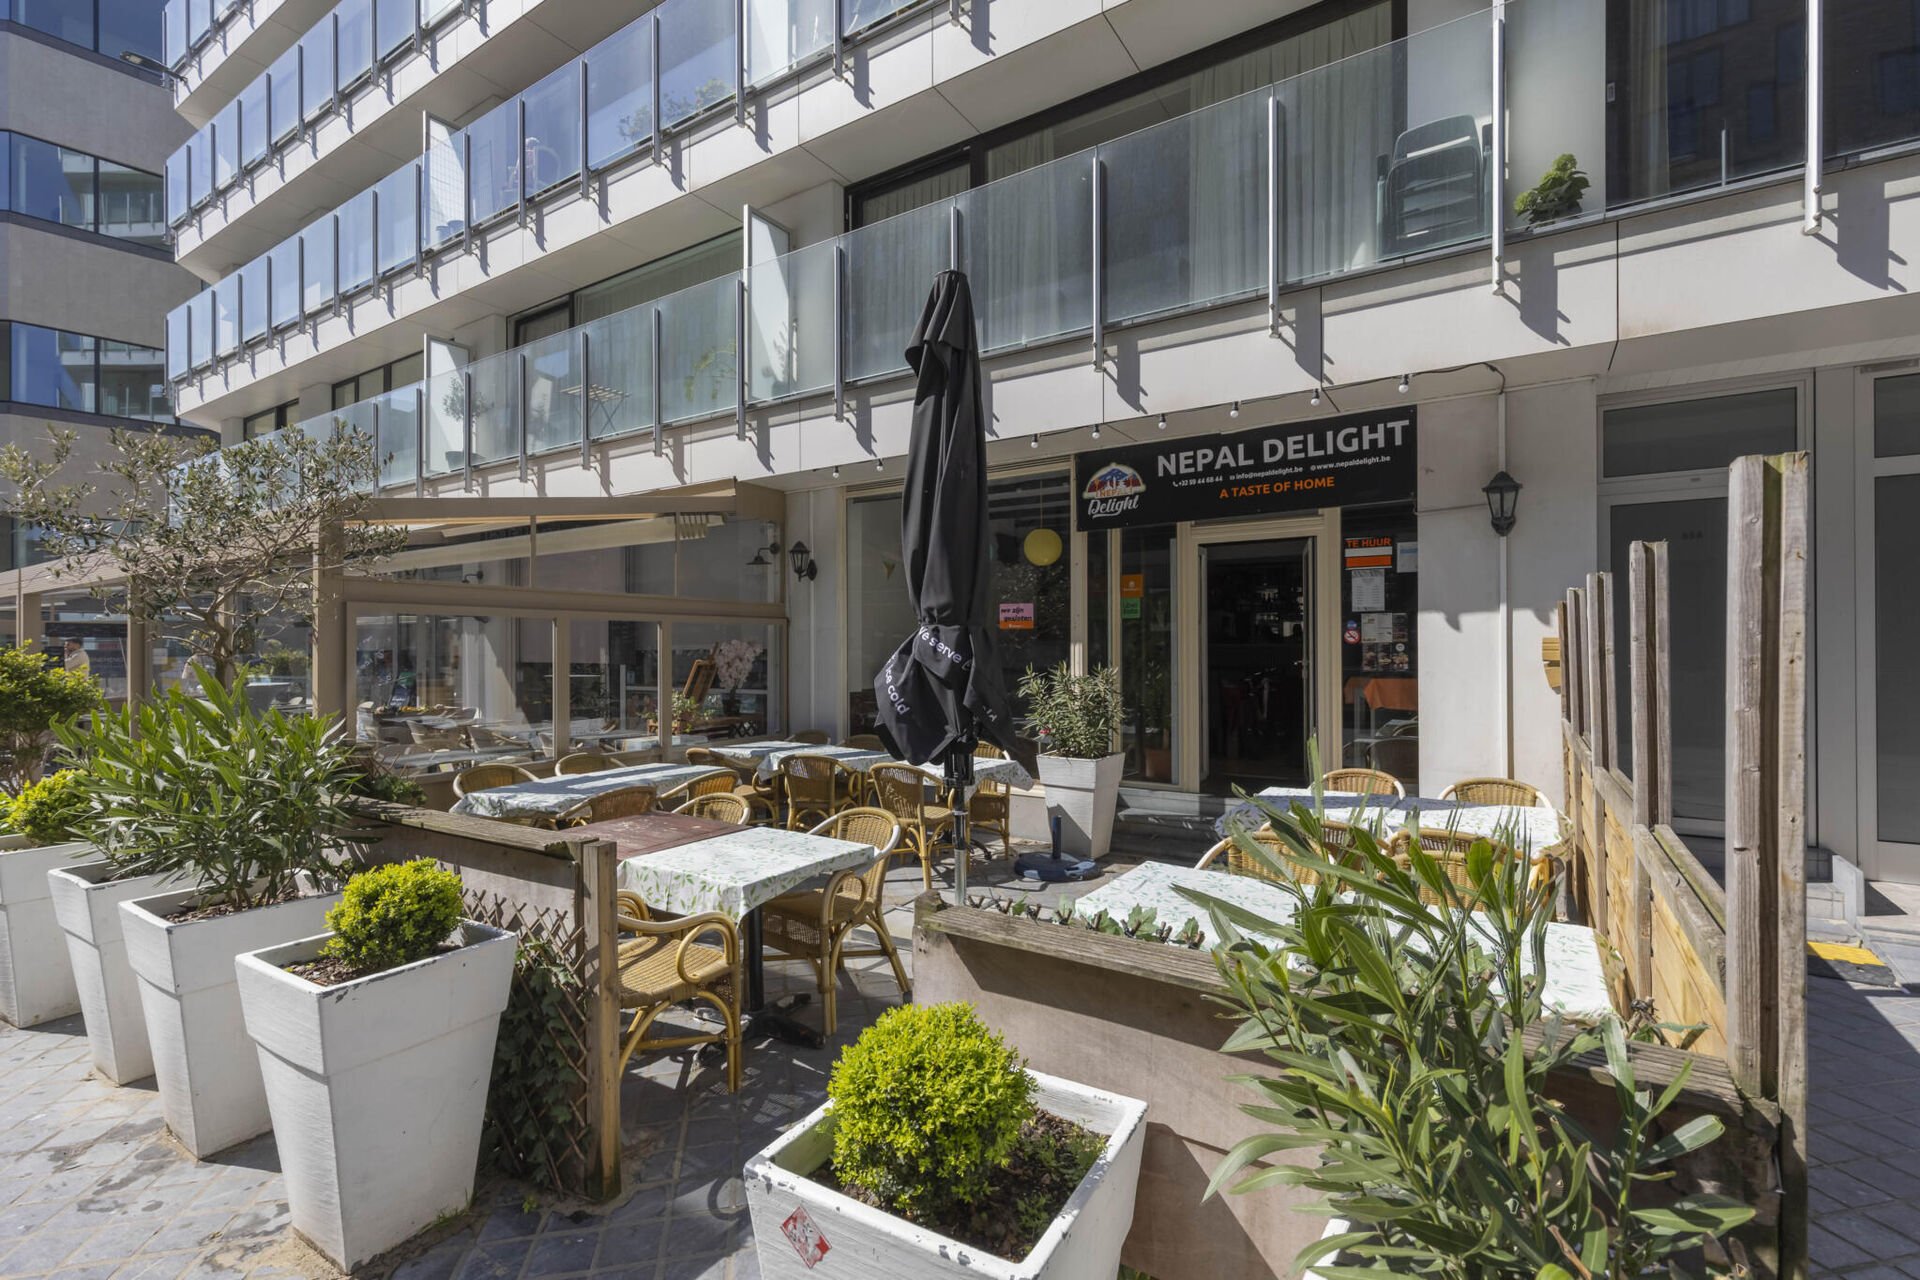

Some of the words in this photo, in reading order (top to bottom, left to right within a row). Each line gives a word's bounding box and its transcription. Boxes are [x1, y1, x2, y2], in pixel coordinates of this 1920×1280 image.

[1157, 443, 1254, 477] NEPAL
[1263, 420, 1410, 463] DELIGHT
[1235, 466, 1303, 480] info@nepaldelight.be
[1316, 455, 1391, 470] www.nepaldelight.be
[1219, 489, 1229, 499] A
[1231, 484, 1271, 498] TASTE
[1273, 480, 1291, 494] OF
[1294, 476, 1335, 490] HOME
[1087, 495, 1139, 519] Delight
[1346, 539, 1359, 548] TE
[1361, 537, 1391, 547] HUUR
[929, 637, 962, 664] serve
[887, 685, 910, 715] cold
